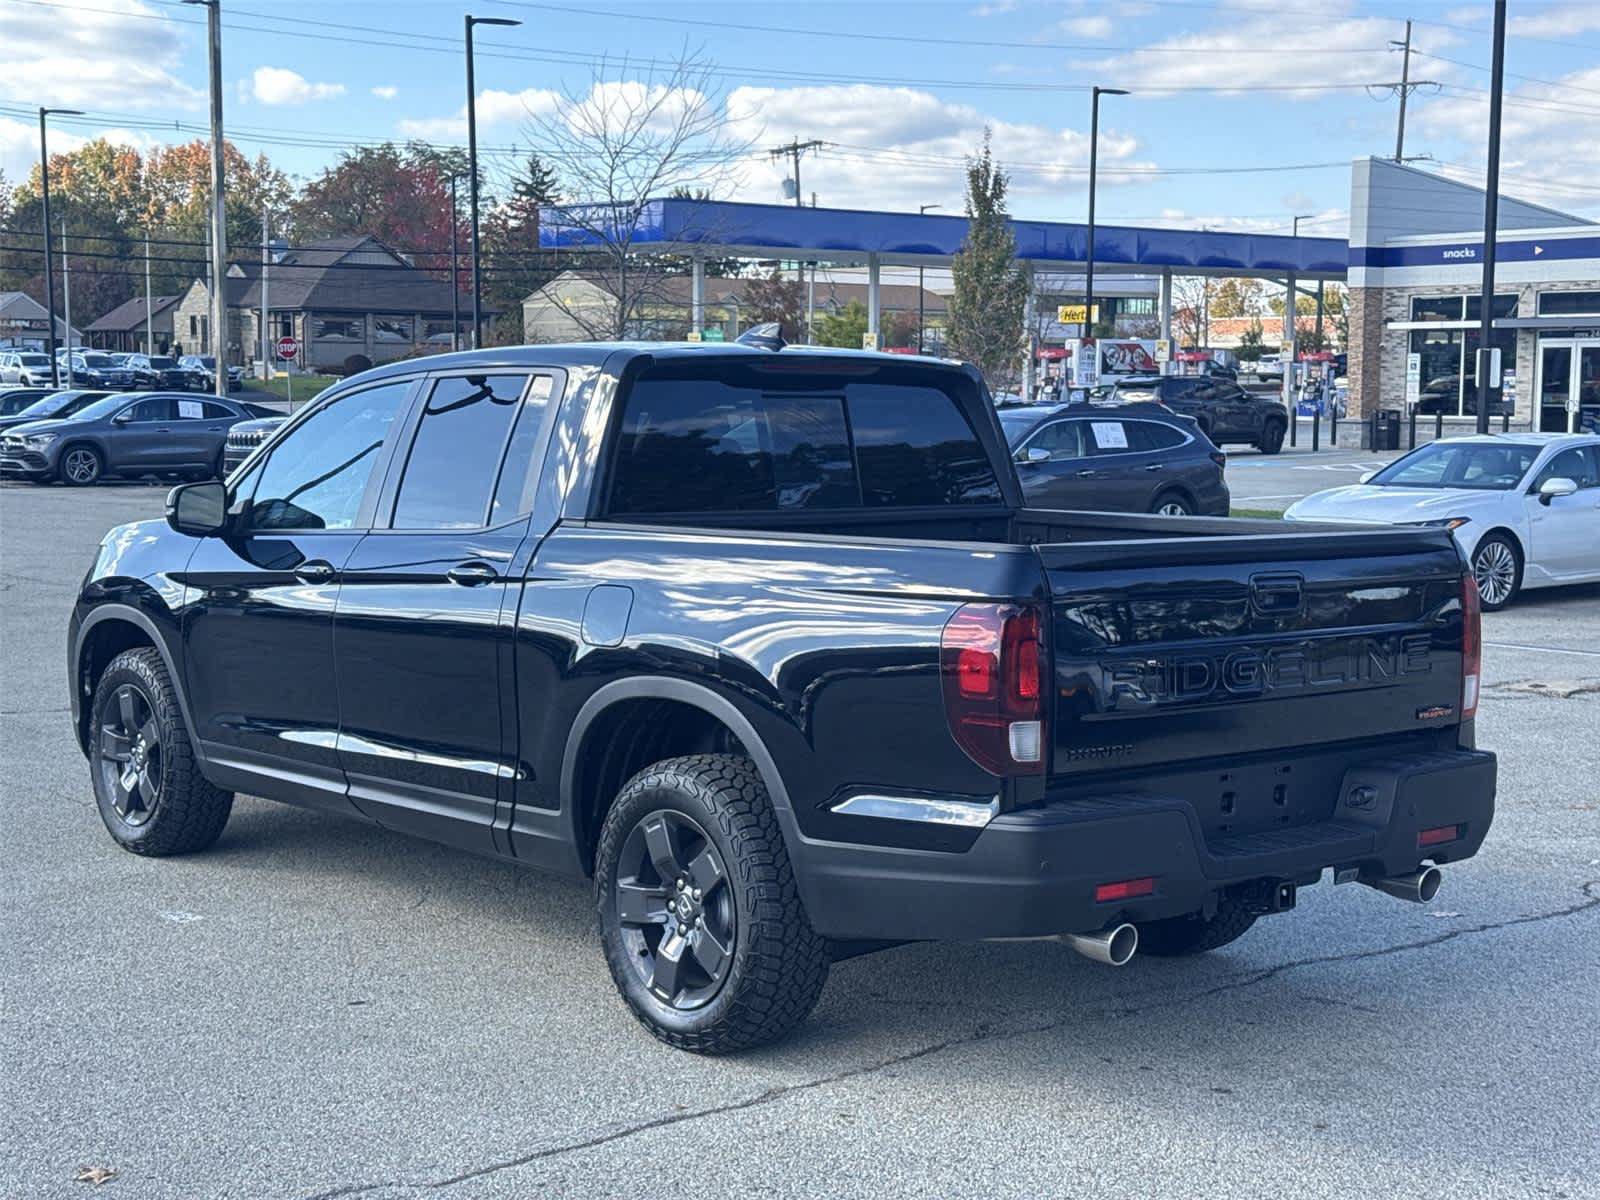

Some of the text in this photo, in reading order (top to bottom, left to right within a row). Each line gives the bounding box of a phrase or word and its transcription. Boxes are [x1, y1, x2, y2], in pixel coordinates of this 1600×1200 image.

[1443, 247, 1476, 259] snacks
[1063, 309, 1087, 321] Hert
[279, 343, 297, 353] STOP
[1100, 633, 1433, 711] RIDGELINE
